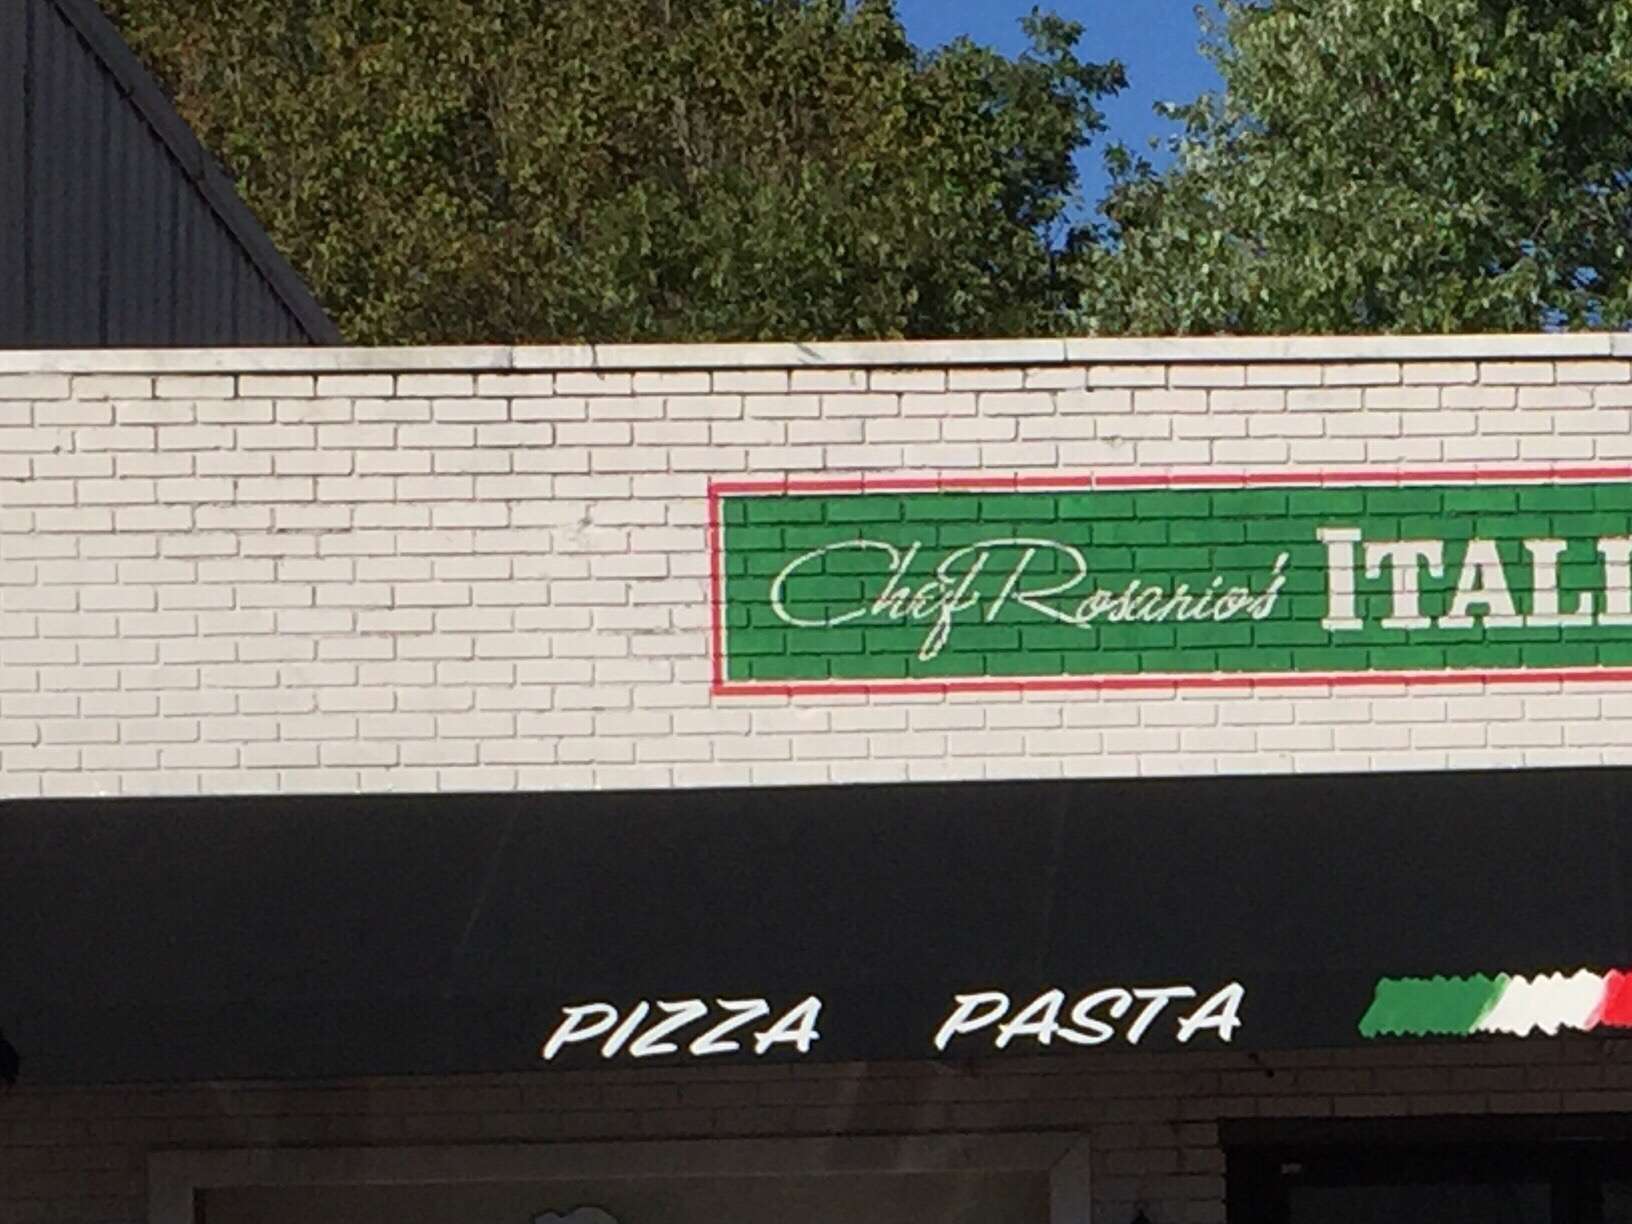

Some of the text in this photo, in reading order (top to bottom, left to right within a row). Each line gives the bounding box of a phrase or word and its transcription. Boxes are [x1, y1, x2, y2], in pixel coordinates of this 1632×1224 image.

[770, 538, 984, 662] Chef
[938, 537, 1289, 631] Rosario's
[541, 980, 1246, 1061] PIZZA PASTA
